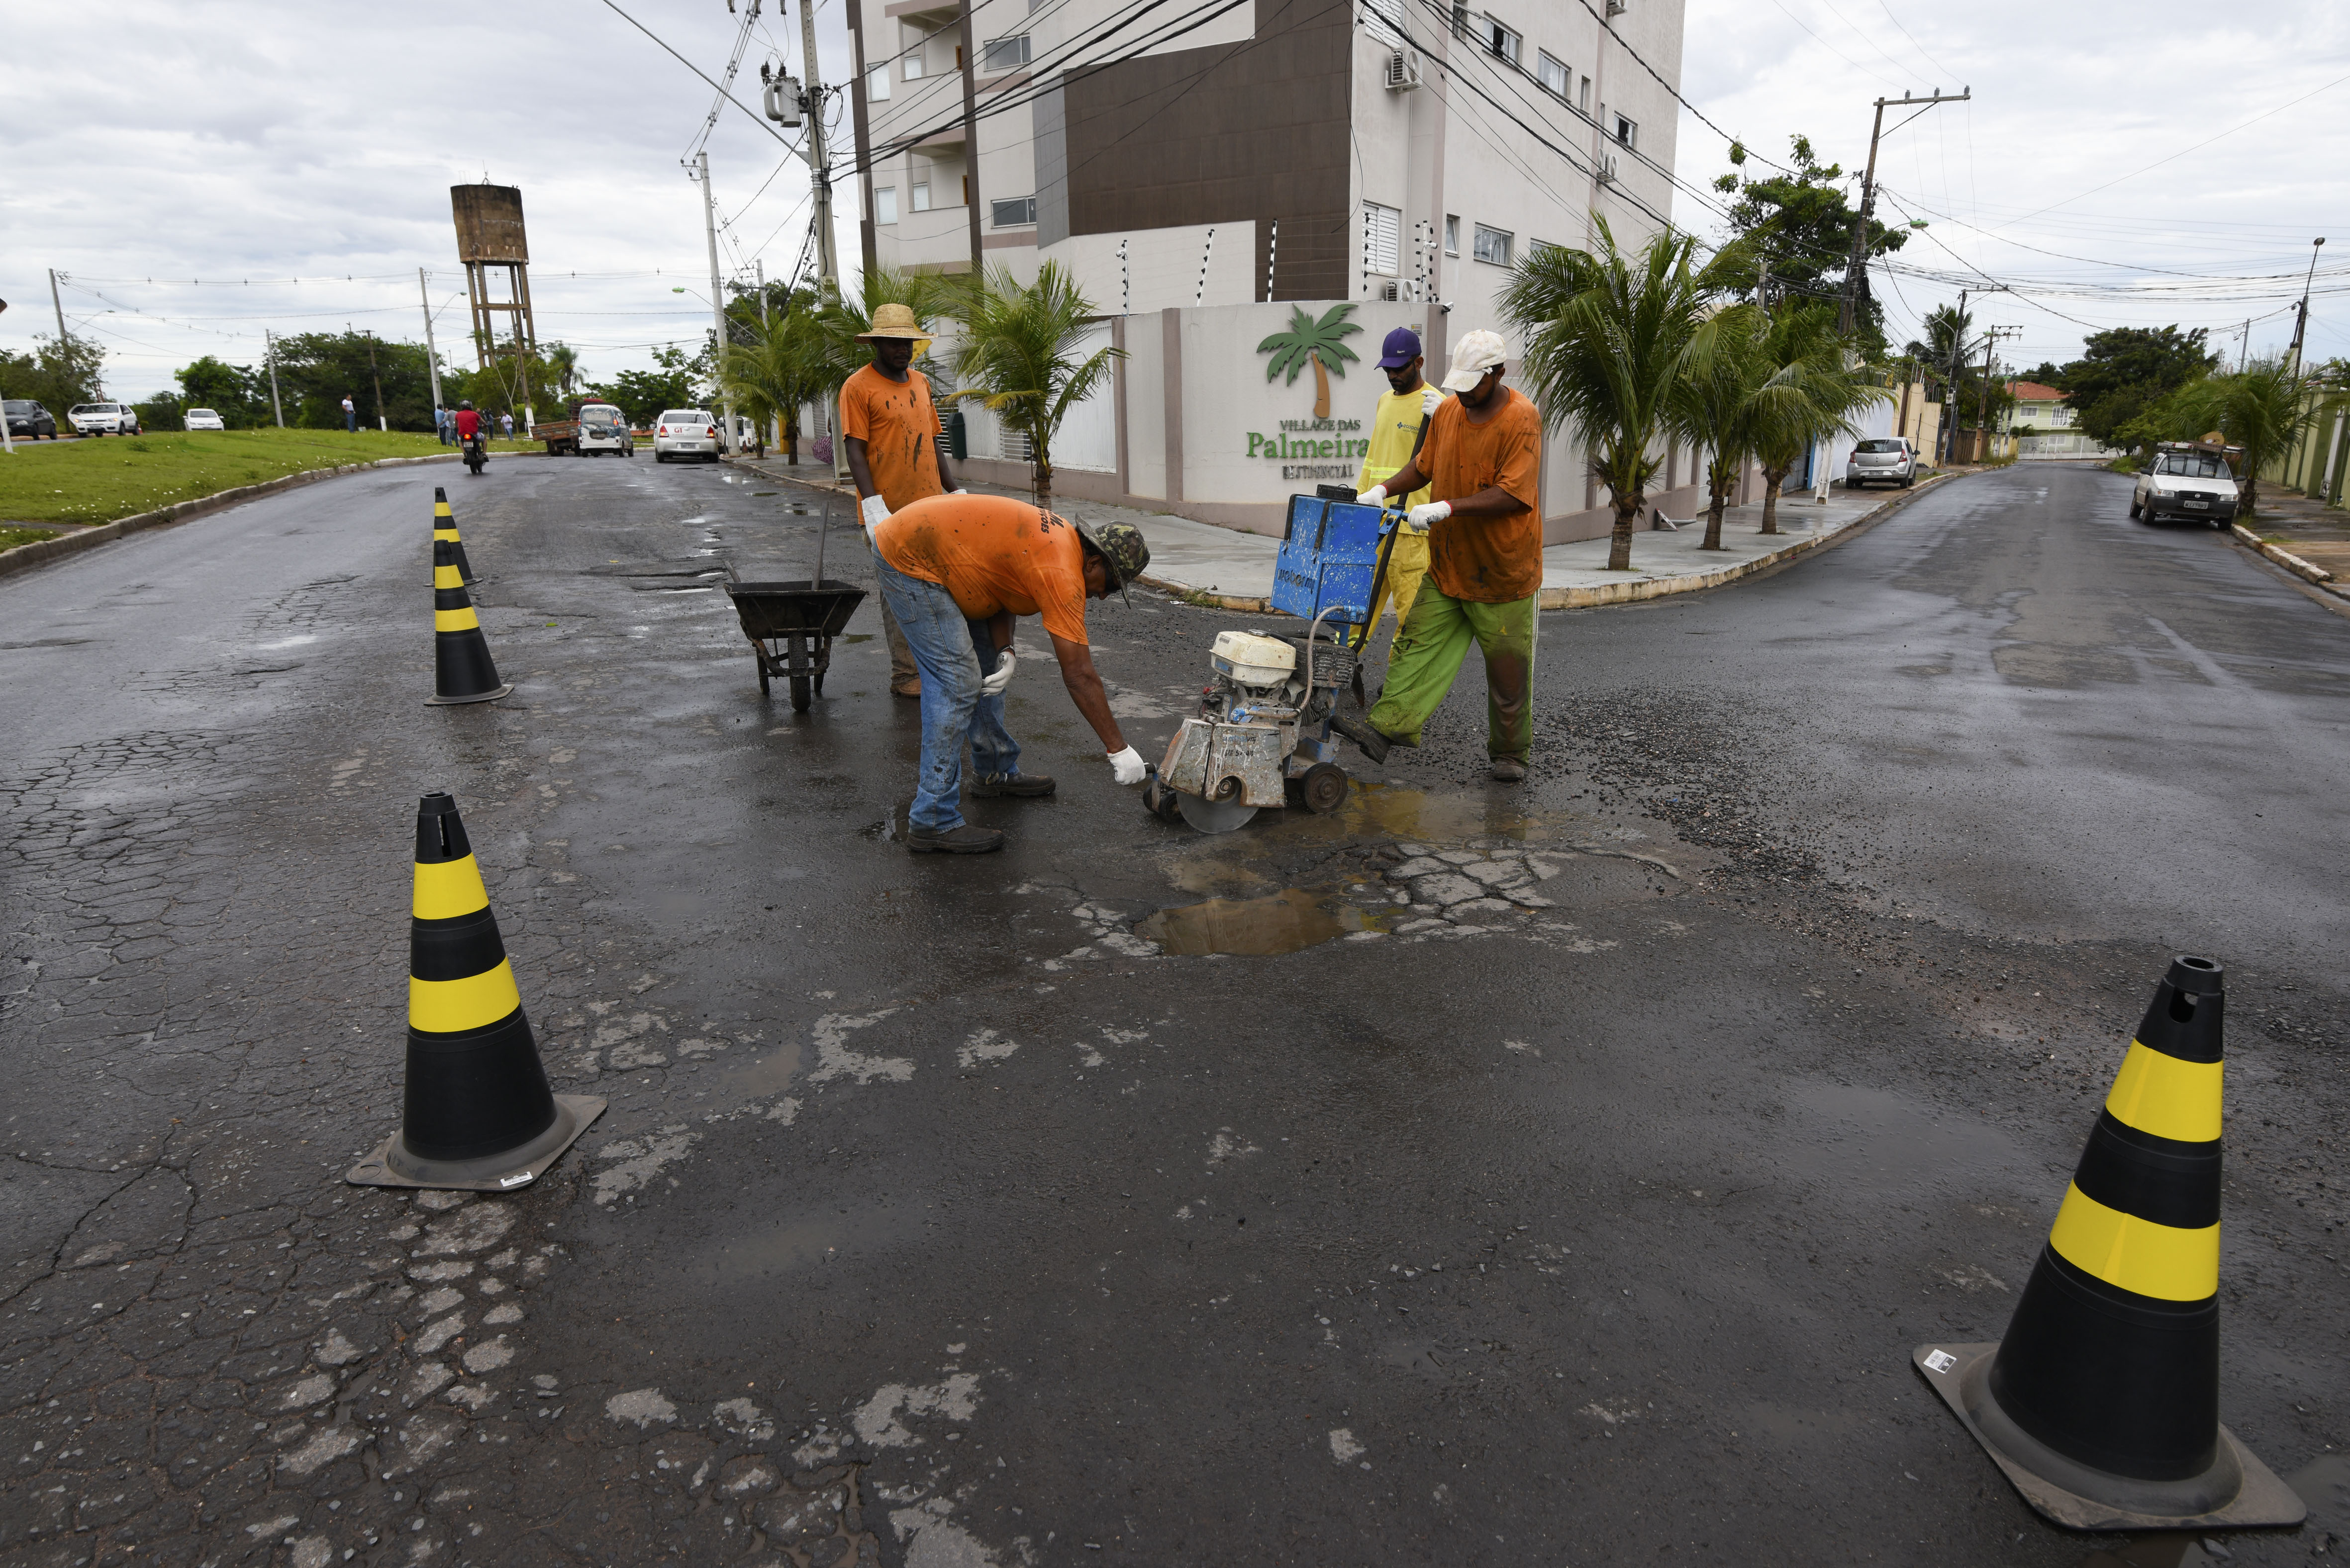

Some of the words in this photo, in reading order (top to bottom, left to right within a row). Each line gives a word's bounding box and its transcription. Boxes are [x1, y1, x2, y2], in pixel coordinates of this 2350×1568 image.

[1279, 419, 1335, 431] VILLAGE
[1338, 418, 1361, 431] DAS
[1246, 432, 1370, 459] Palmeira
[1281, 464, 1355, 479] RESIDENCIAL
